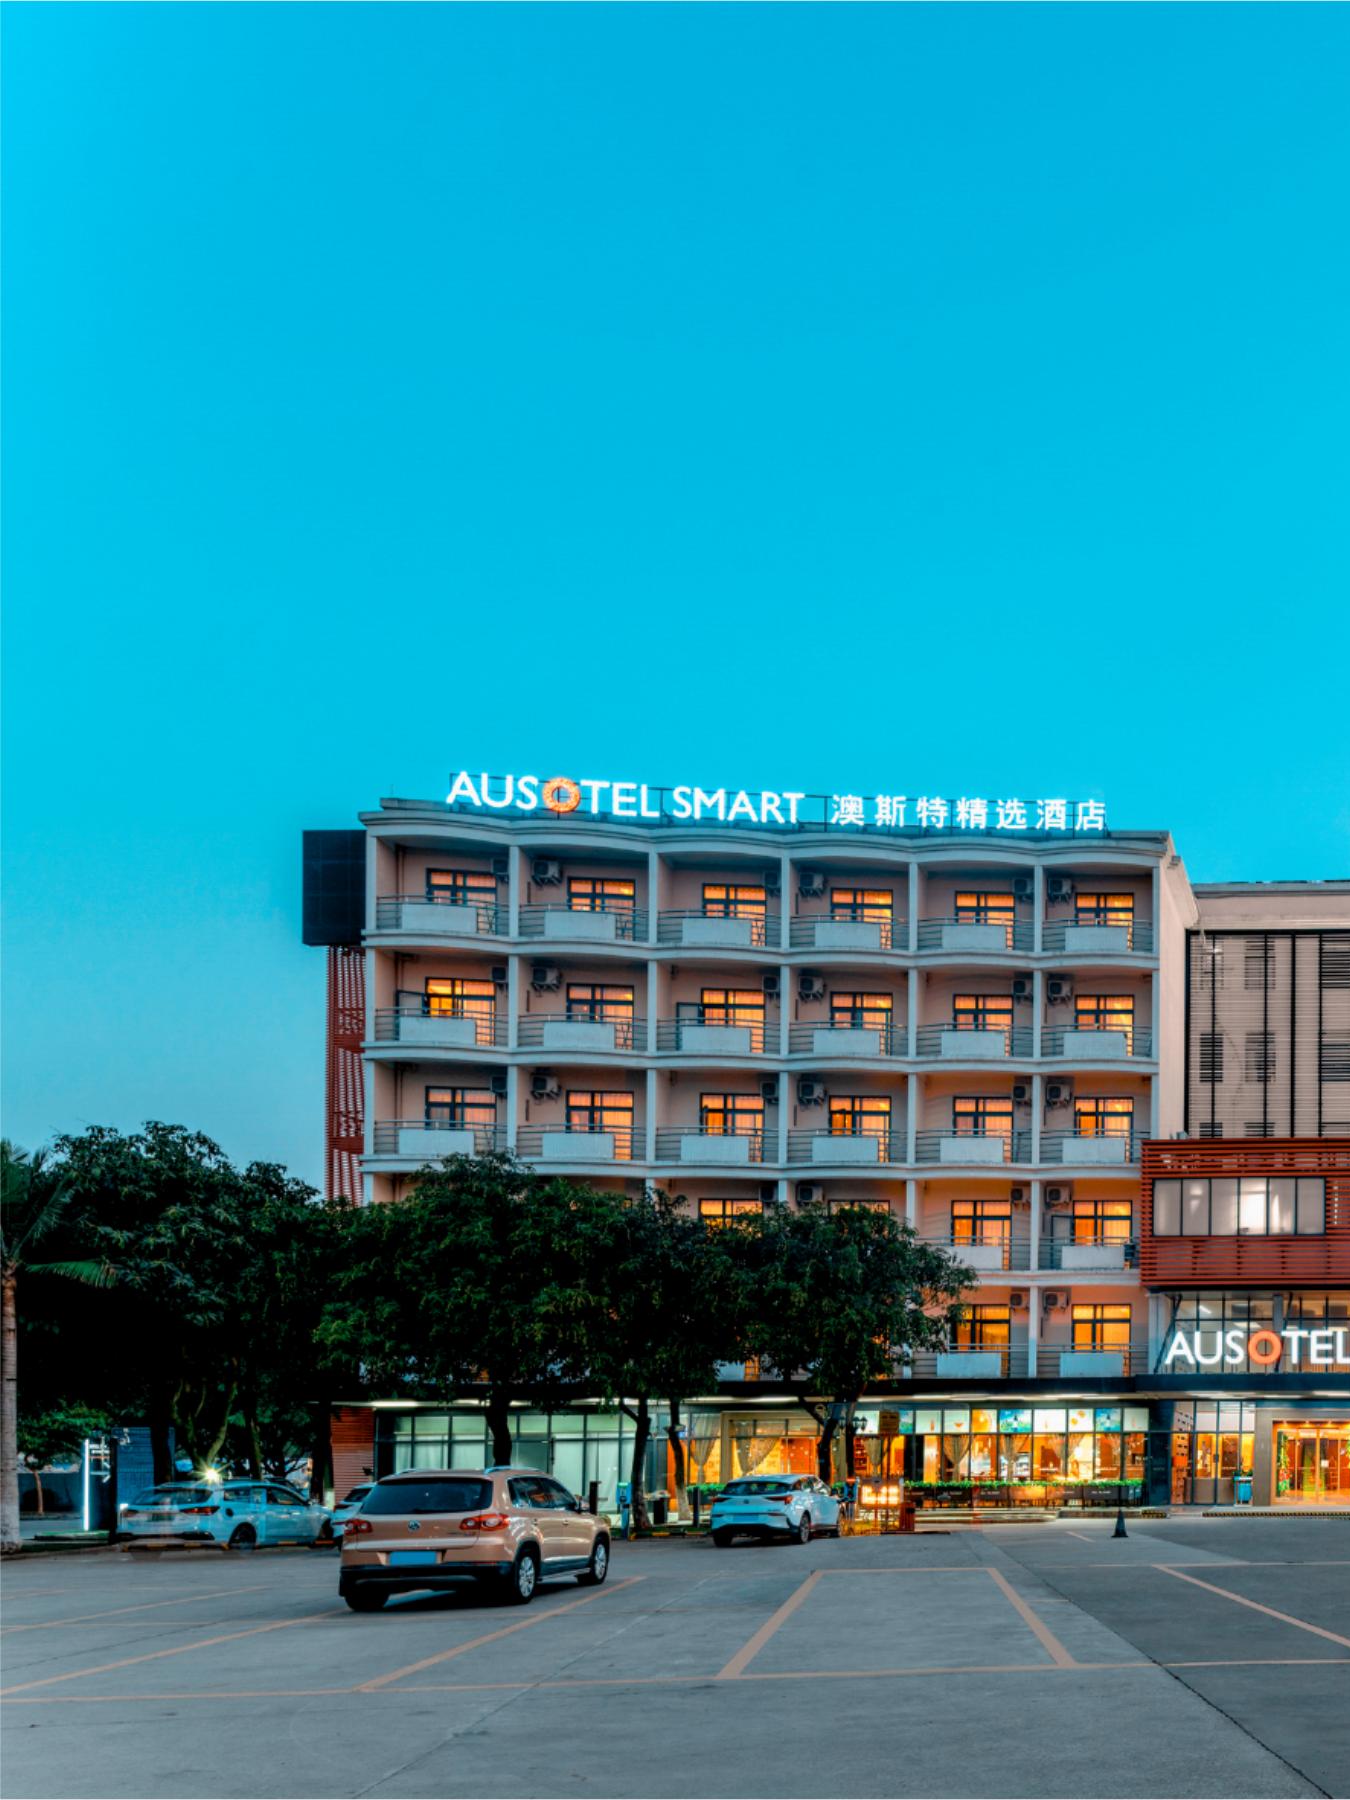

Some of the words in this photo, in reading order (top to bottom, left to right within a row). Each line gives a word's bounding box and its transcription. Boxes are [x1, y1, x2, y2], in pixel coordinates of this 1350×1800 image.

[446, 771, 660, 817] AUSOTEL
[672, 786, 805, 824] SMART
[831, 794, 1106, 831] 澳斯特精选酒店
